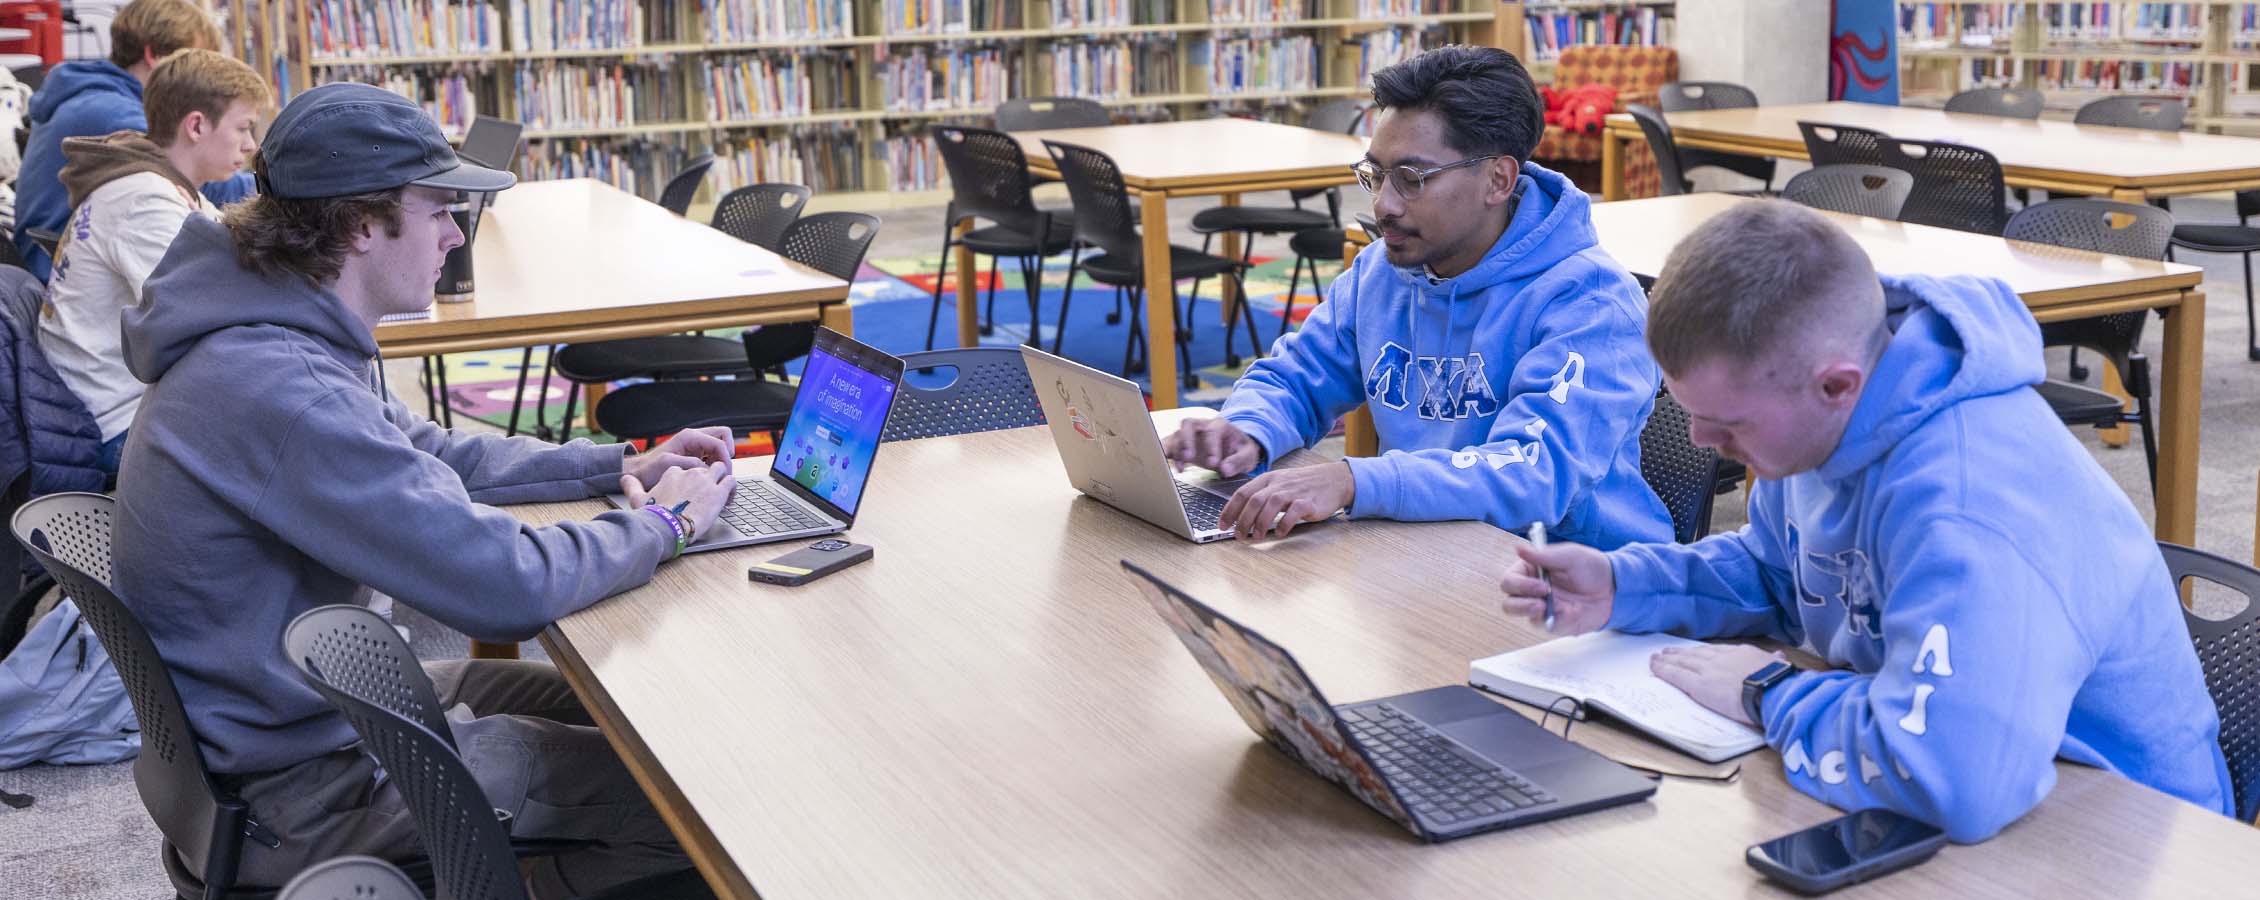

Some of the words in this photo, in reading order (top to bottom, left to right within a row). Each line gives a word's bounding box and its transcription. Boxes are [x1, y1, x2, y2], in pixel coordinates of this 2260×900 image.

[829, 372, 837, 388] A
[836, 378, 850, 392] new
[849, 384, 861, 400] era
[817, 389, 828, 402] of
[825, 391, 862, 421] imagination
